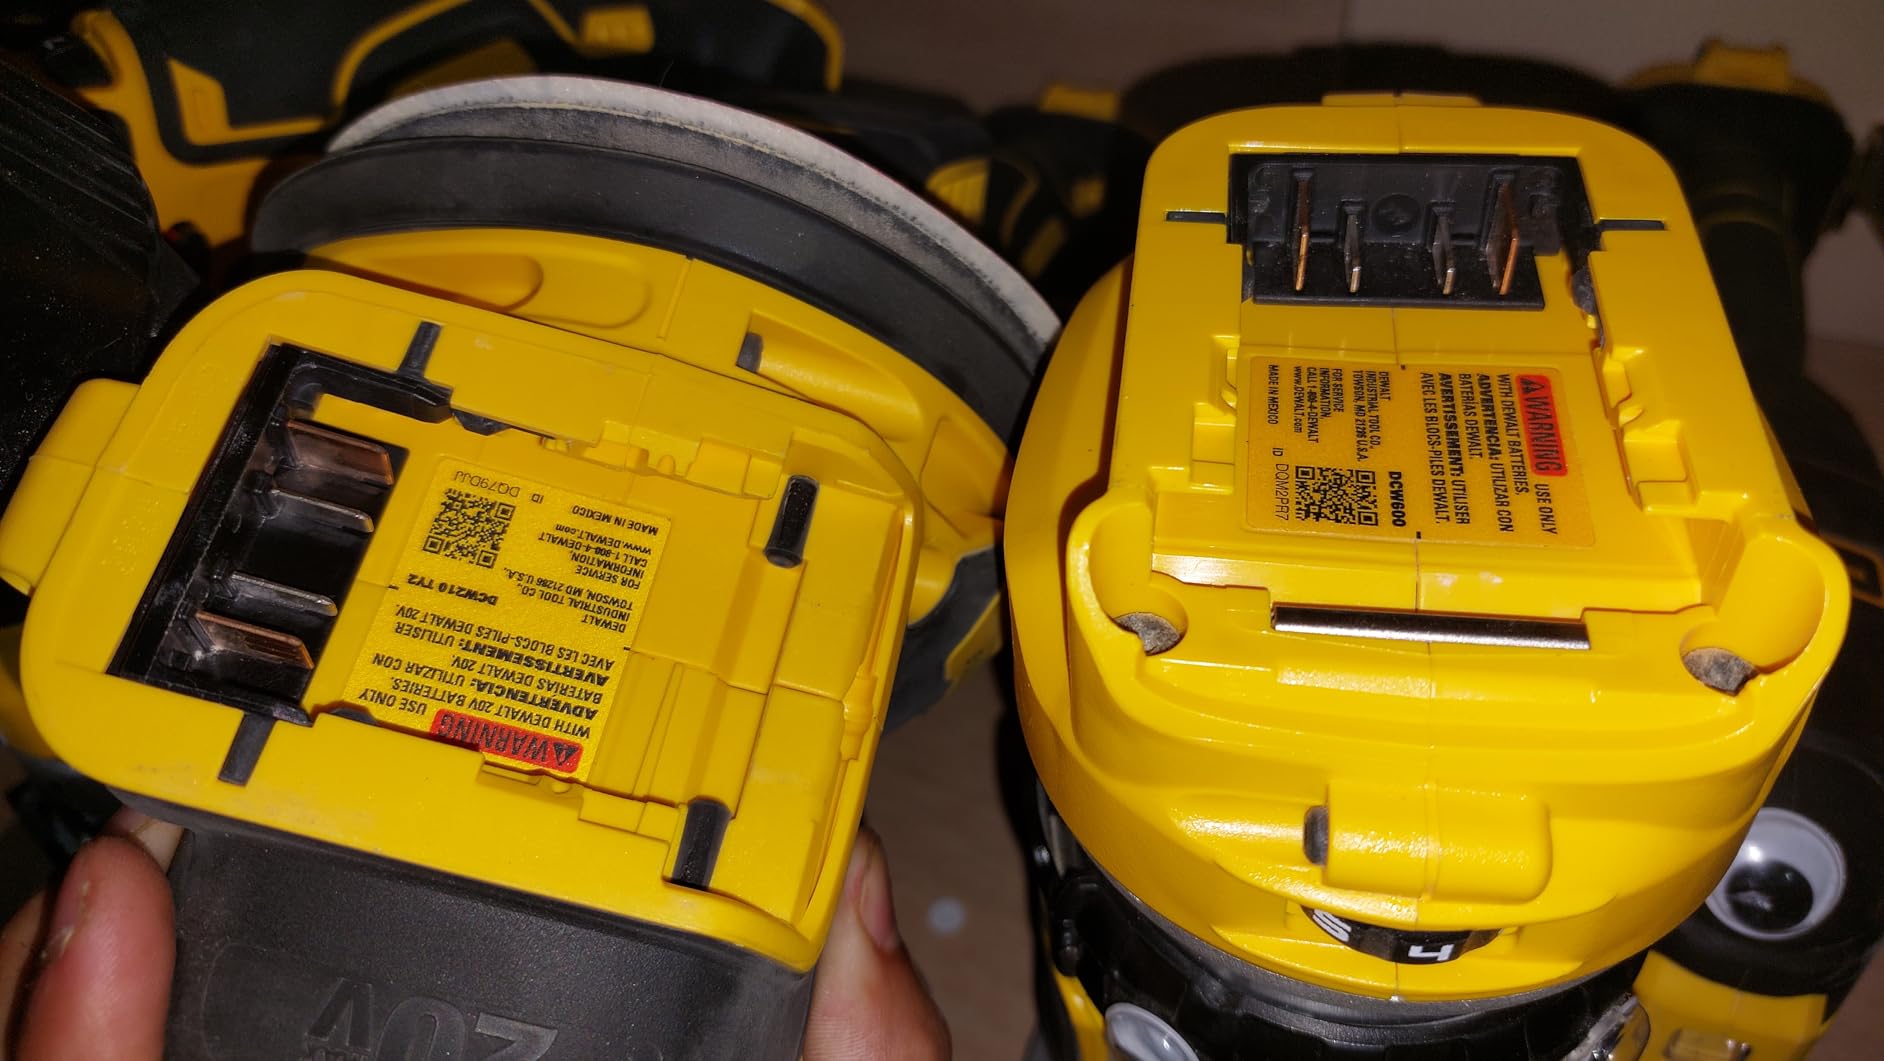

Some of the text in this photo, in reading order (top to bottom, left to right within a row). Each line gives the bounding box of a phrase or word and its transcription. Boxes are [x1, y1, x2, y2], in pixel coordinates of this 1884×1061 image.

[1306, 366, 1317, 383] CALL
[1331, 367, 1344, 412] FOR SERVICE
[1352, 369, 1365, 403] TOWSON,
[1365, 370, 1379, 413] INDUSTRIAL
[1378, 370, 1391, 400] DEWALT
[1497, 373, 1513, 397] WITH
[1267, 363, 1279, 424] MADE IN MEXICO
[1293, 365, 1305, 433] www.DEWALT.com
[1353, 403, 1366, 417] MD
[1367, 414, 1380, 433] TOOL
[1458, 372, 1483, 459] BATERÍAS DEWALT.
[1500, 399, 1520, 438] DEWALT
[1419, 372, 1450, 524] AVEC LES BLOCS-PILES DEWALT.
[1438, 372, 1470, 524] AVERTISSEMENT: UTILISER
[1524, 396, 1562, 471] WARNING
[1476, 372, 1514, 532] ADVERTENCIA: UTILIZAR CON
[530, 492, 544, 503] ID
[1271, 447, 1289, 520] ID DQM2PR7
[1387, 470, 1406, 527] DCW600
[571, 504, 658, 536] MADE IN MEXICO
[1533, 483, 1557, 534] USE ONLY
[554, 523, 651, 555] www.DEWALT.com
[623, 552, 647, 567] CALL
[406, 572, 498, 606] DCW210 TY2
[564, 584, 584, 597] MD
[574, 564, 640, 590] FOR SERVICE
[538, 588, 564, 604] TOOL
[567, 596, 630, 622] INDUSTRIAL
[585, 588, 632, 611] TOWSON,
[394, 604, 615, 671] AVEC LES BLOCS-PILES DEWALT 20V.
[580, 613, 626, 633] DEWALT
[394, 621, 610, 687] AVERTISSEMENT: UTILISER
[371, 652, 598, 720] ADVERTENCIA: UTILIZAR CON
[450, 654, 603, 704] BATERÍAS DEWALT 20V.
[357, 687, 427, 715] USE ONLY
[390, 676, 590, 739] WITH DEWALT 20V BATTERIES.
[1408, 944, 1455, 961] 4
